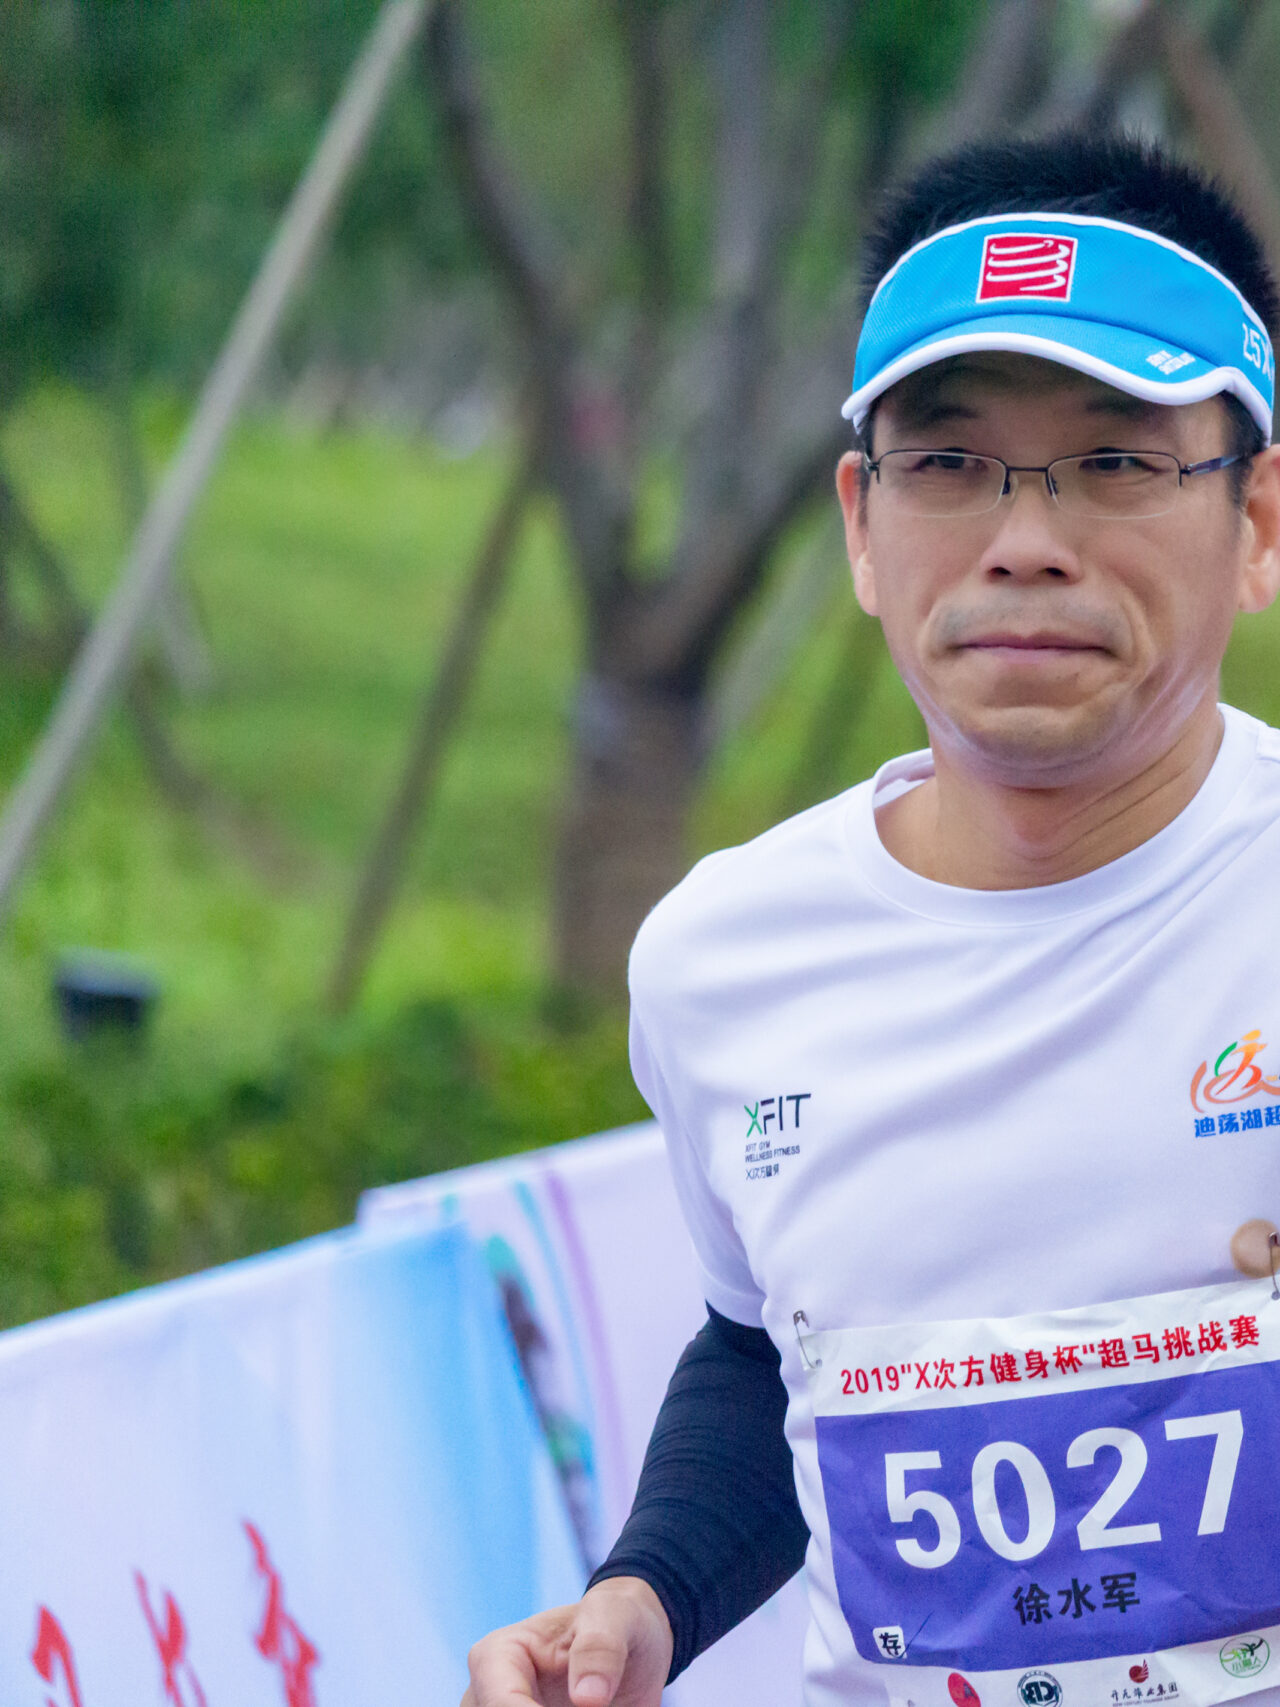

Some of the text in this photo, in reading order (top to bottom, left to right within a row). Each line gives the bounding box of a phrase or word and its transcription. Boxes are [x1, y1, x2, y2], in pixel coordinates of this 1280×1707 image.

[744, 1093, 811, 1138] XFIT
[745, 1145, 800, 1163] WELLNESS FITNESS
[885, 1410, 1244, 1569] 5027
[1014, 1572, 1140, 1625] 徐水军
[879, 1632, 901, 1656] 存
